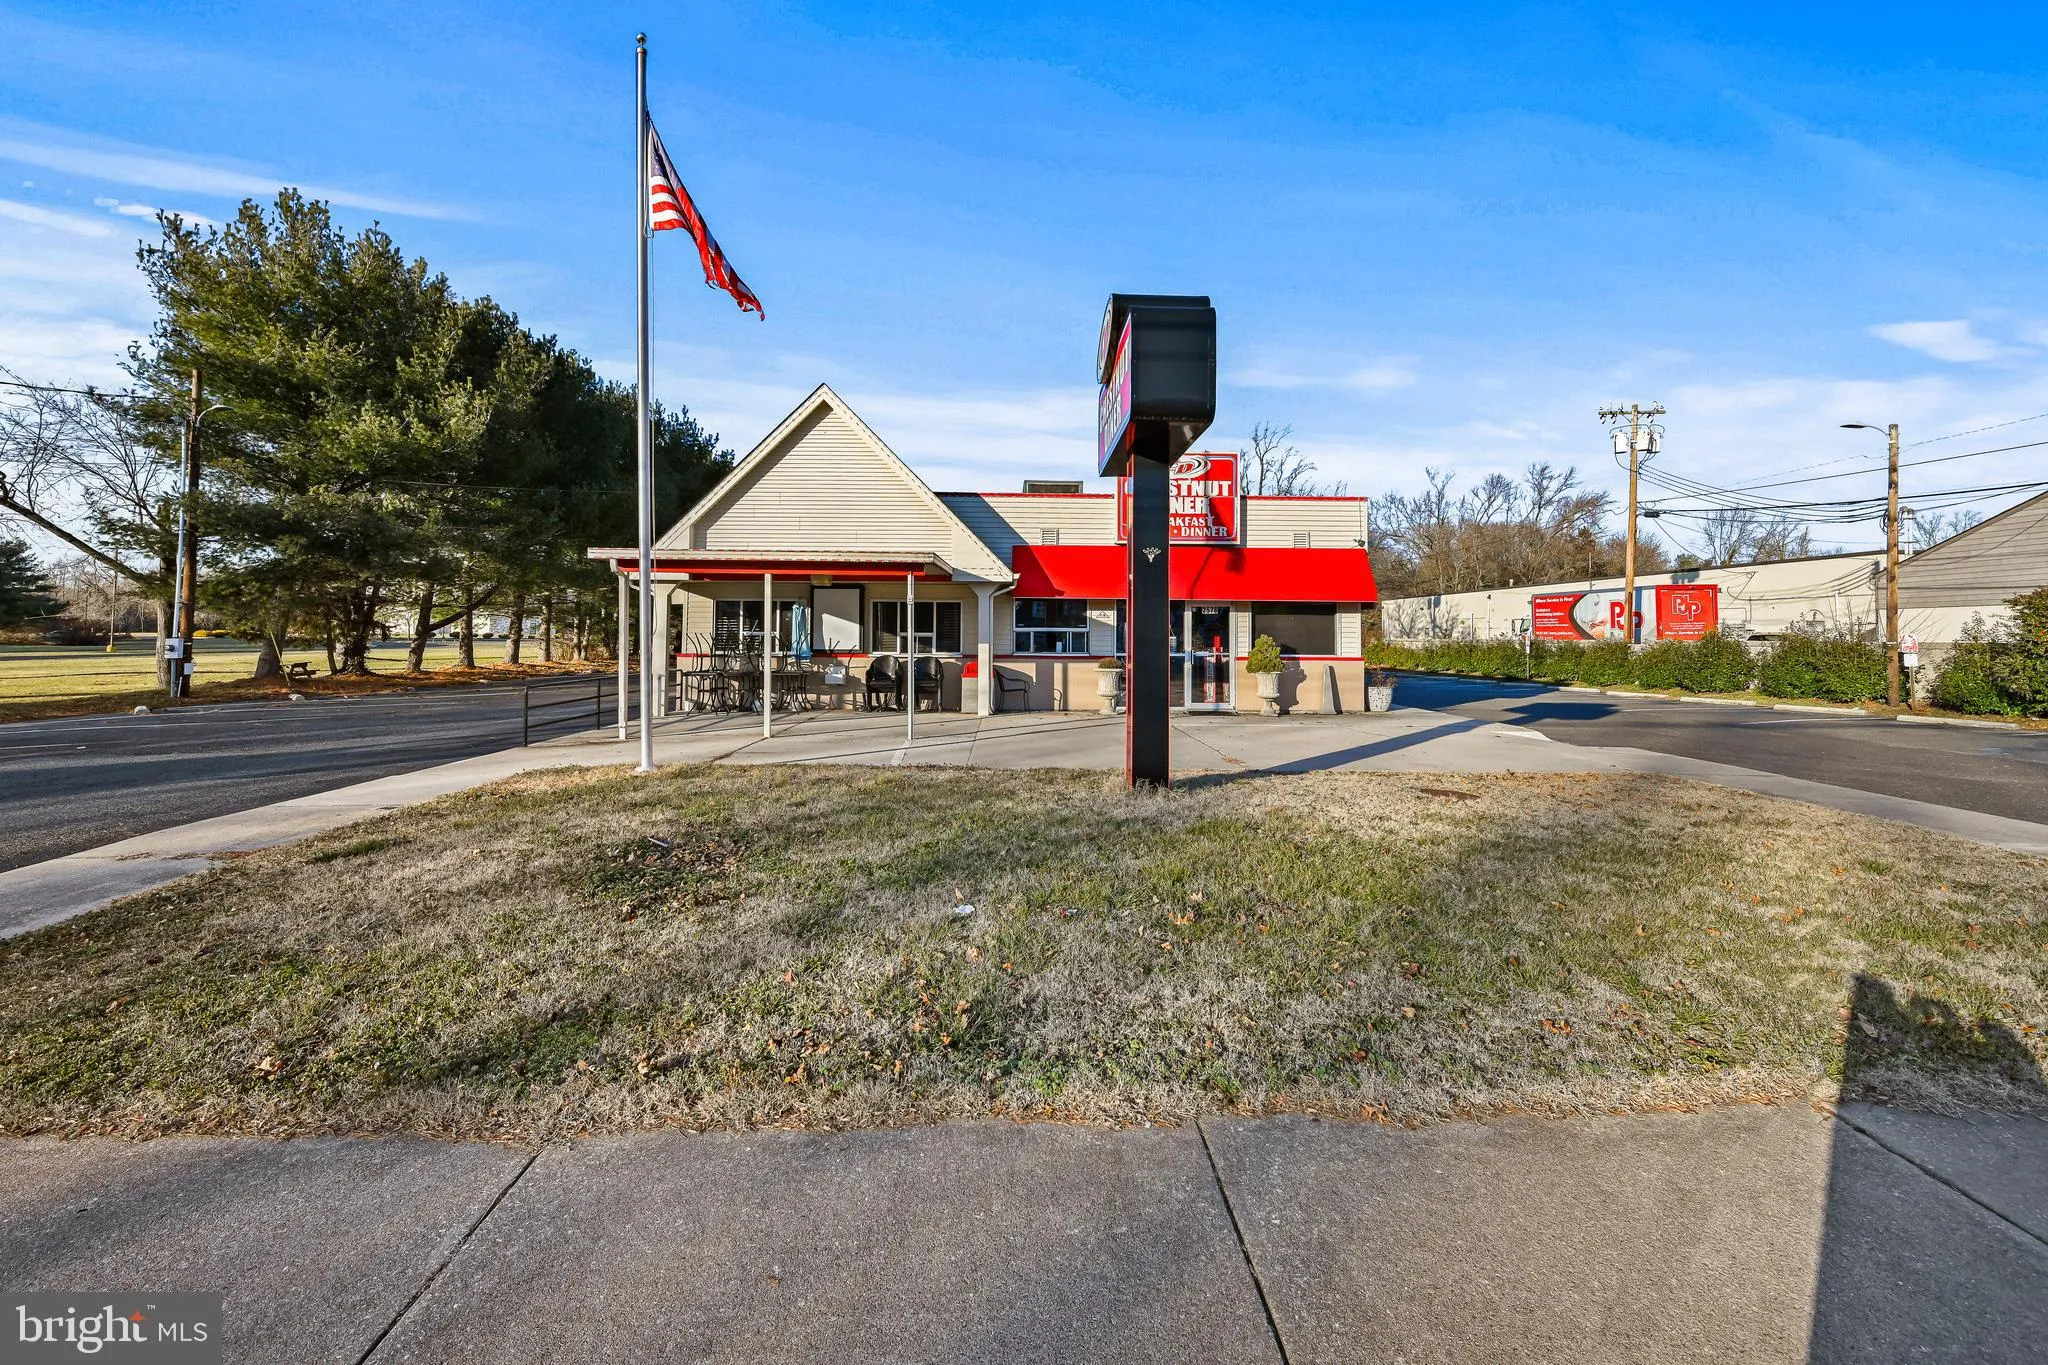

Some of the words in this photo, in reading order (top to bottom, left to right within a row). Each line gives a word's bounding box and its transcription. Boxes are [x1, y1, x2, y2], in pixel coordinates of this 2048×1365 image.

[1169, 497, 1210, 514] NER
[1169, 516, 1214, 527] AKFAST
[1181, 526, 1228, 537] DINNER
